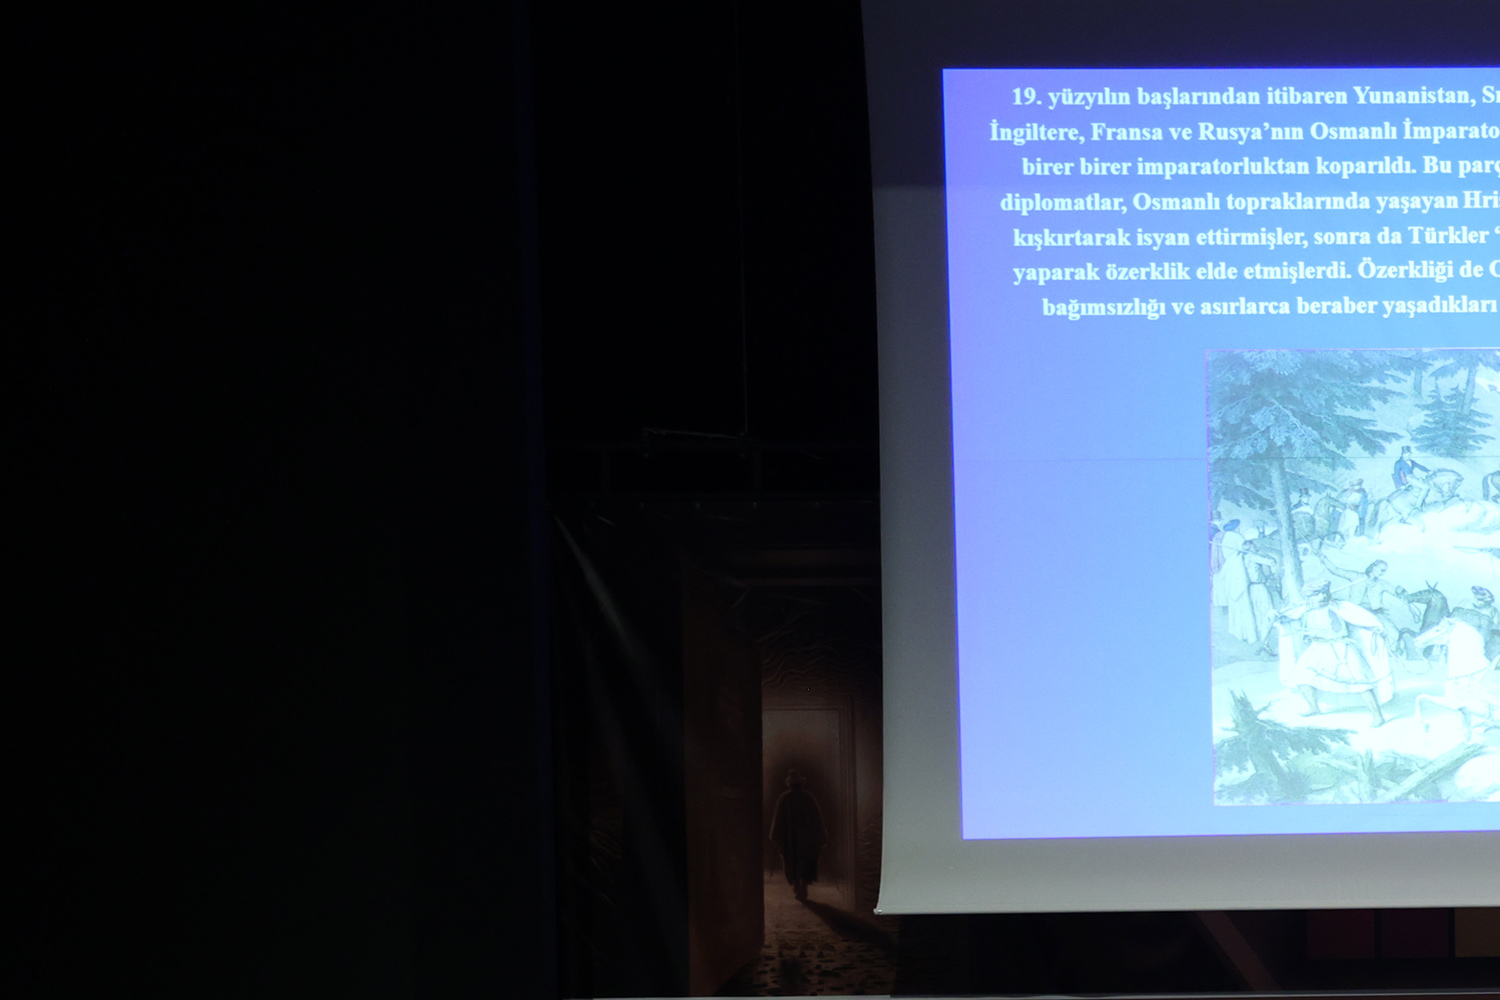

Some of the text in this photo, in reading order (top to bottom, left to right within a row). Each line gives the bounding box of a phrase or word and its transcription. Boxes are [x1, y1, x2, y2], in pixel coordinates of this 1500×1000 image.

[1012, 86, 1043, 106] 19.
[1047, 86, 1131, 111] yüzyılın
[1136, 85, 1261, 110] başlarından
[1266, 85, 1349, 105] itibaren
[1352, 84, 1477, 108] Yunanistan,
[989, 117, 1086, 146] İngiltere,
[1090, 122, 1164, 142] Fransa
[1168, 127, 1193, 141] ve
[1197, 121, 1305, 146] Rusya’nın
[1309, 121, 1398, 141] Osmanlı
[1021, 157, 1075, 176] birer
[1079, 156, 1133, 176] birer
[1136, 155, 1311, 181] imparatorluktan
[1315, 155, 1418, 180] koparıldı.
[1422, 155, 1453, 174] Bu
[1000, 191, 1128, 217] diplomatlar,
[1132, 191, 1221, 211] Osmanlı
[1225, 191, 1371, 215] topraklarında
[1375, 194, 1460, 215] yaşayan
[1012, 227, 1132, 252] kışkırtarak
[1136, 226, 1191, 251] isyan
[1195, 227, 1309, 252] ettirmişler,
[1313, 231, 1372, 246] sonra
[1376, 226, 1403, 246] da
[1407, 225, 1491, 245] Türkler
[1012, 262, 1101, 286] yaparak
[1105, 261, 1192, 281] özerklik
[1195, 261, 1239, 280] elde
[1243, 260, 1353, 285] etmişlerdi.
[1357, 255, 1455, 284] Özerkliği
[1458, 259, 1485, 279] de
[1041, 297, 1167, 322] bağımsızlığı
[1170, 301, 1196, 316] ve
[1200, 296, 1291, 316] asırlarca
[1295, 295, 1379, 315] beraber
[1381, 294, 1498, 319] yaşadıkları
